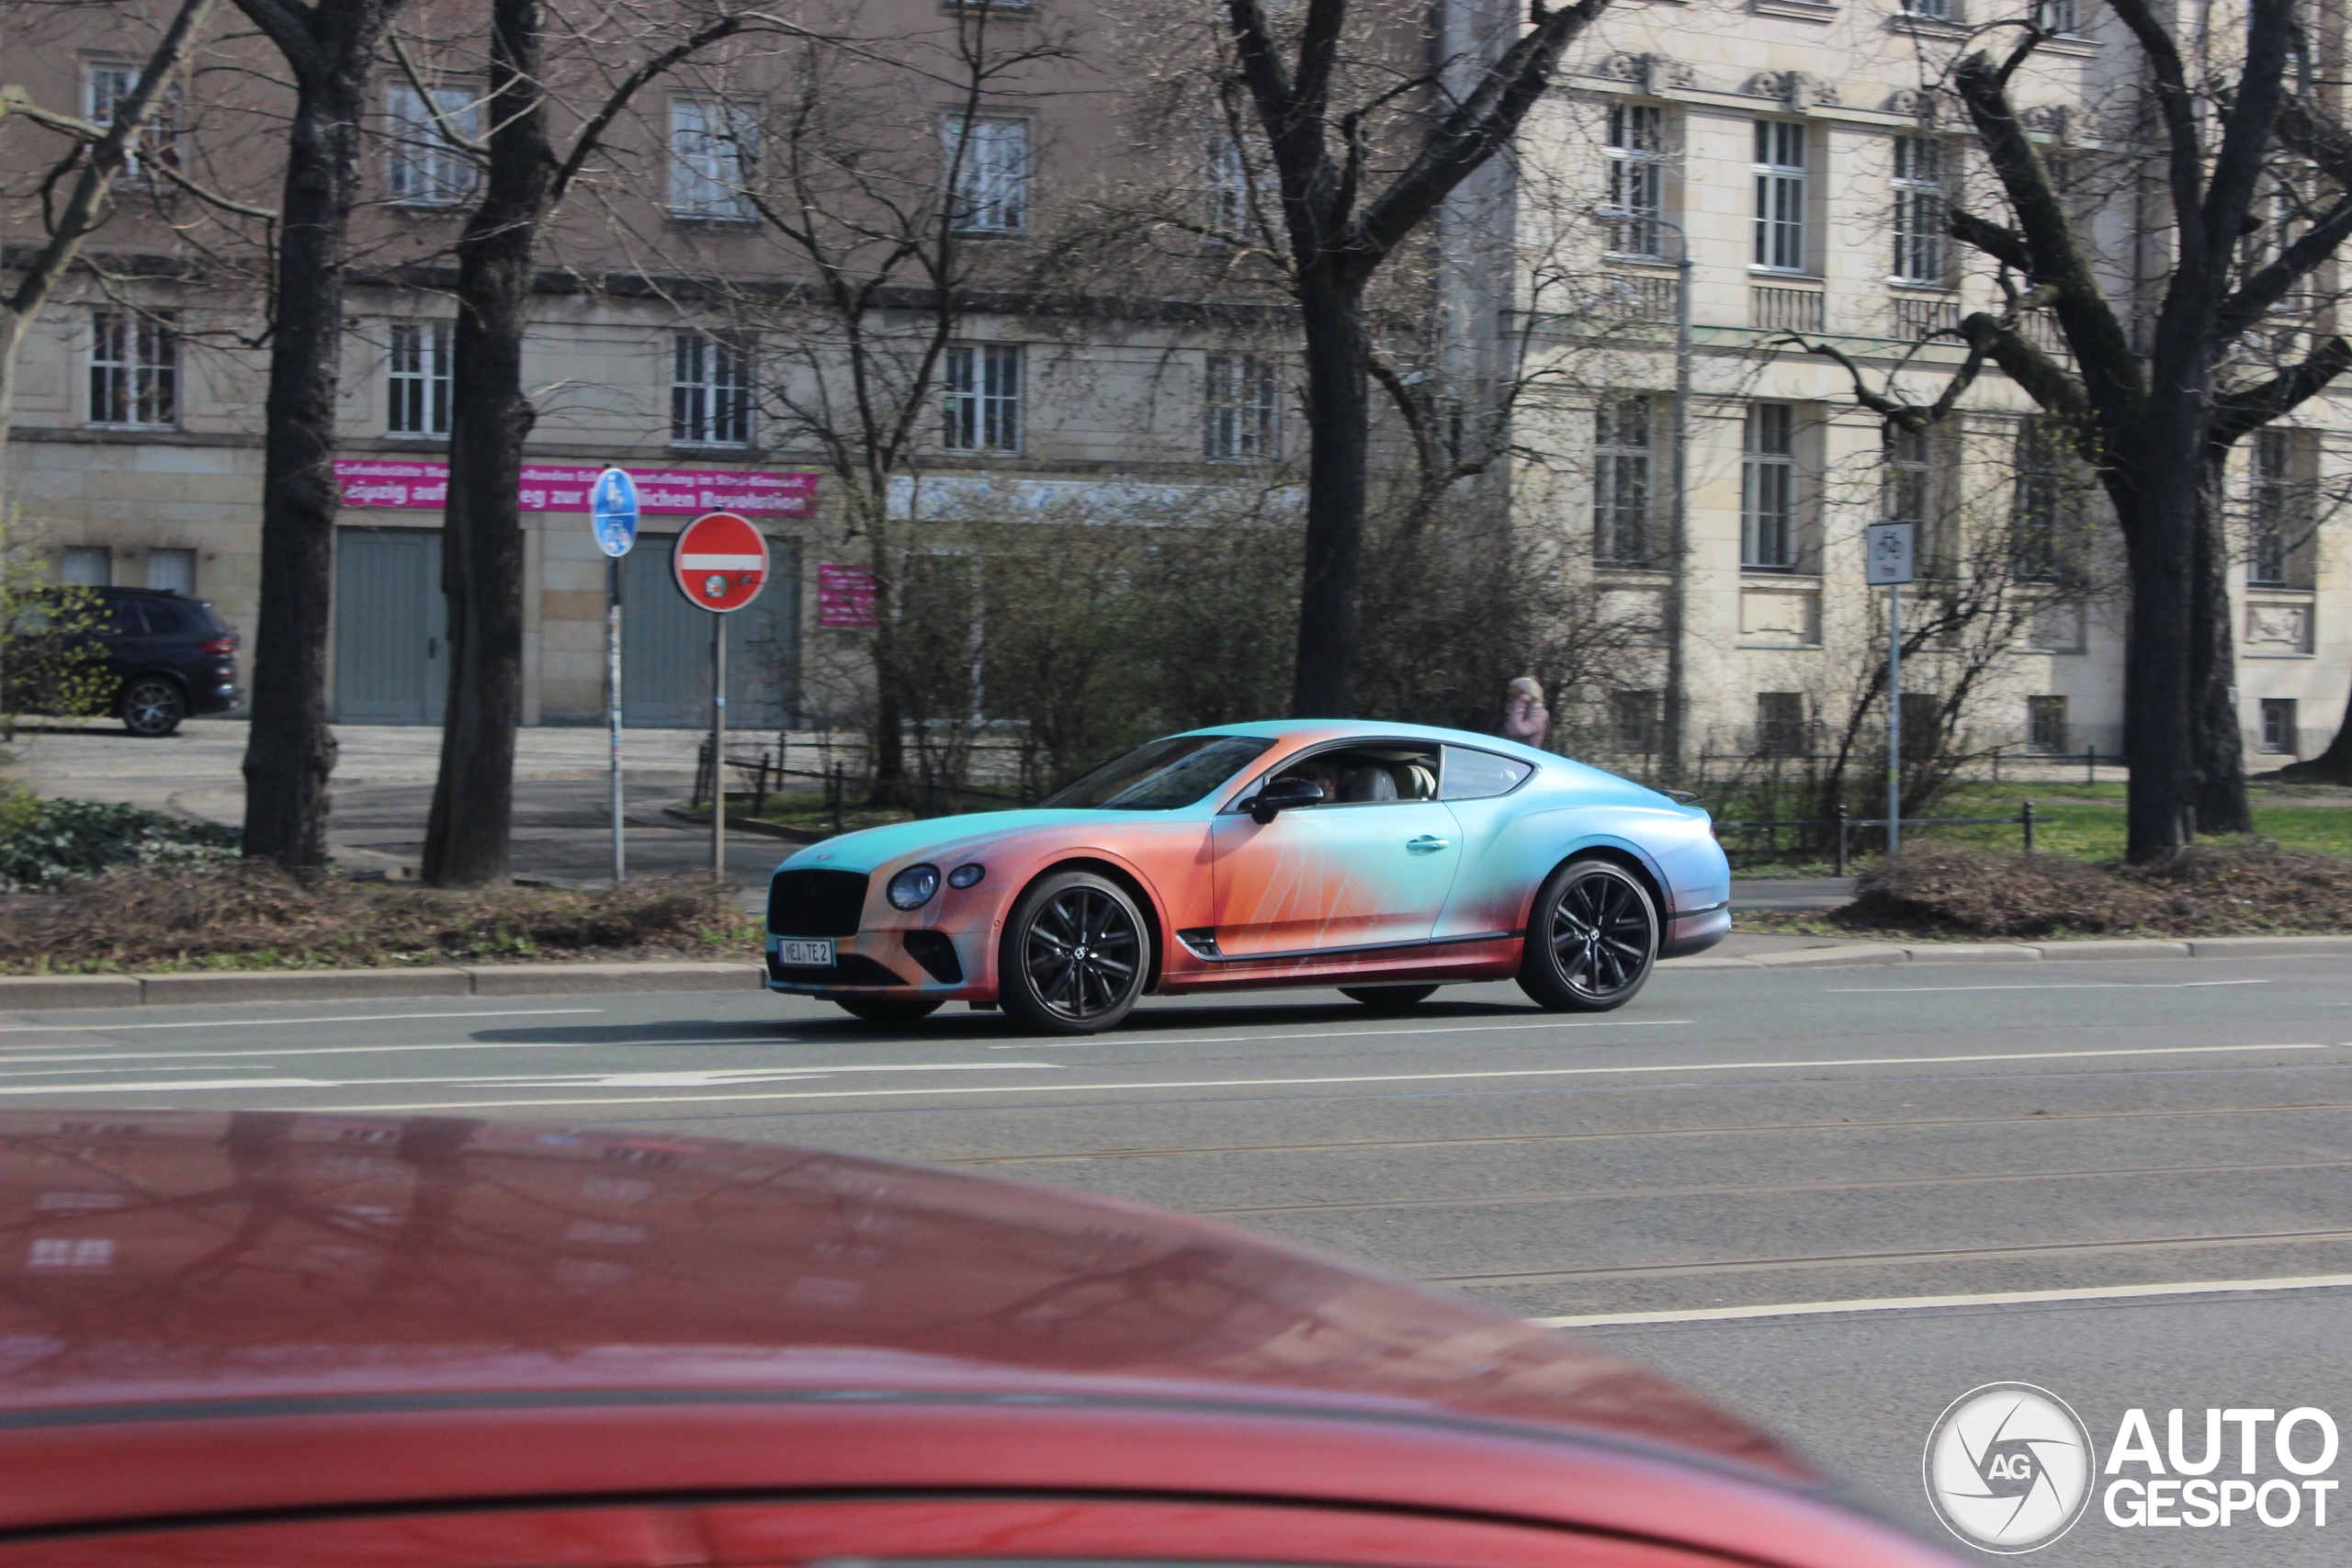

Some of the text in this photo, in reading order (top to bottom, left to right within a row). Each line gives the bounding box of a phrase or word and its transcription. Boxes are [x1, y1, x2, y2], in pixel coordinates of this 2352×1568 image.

[344, 479, 408, 505] eipzig
[519, 490, 546, 508] eg
[551, 491, 583, 504] zur
[699, 491, 806, 510] Revolution
[786, 943, 828, 962] MEI TE 2
